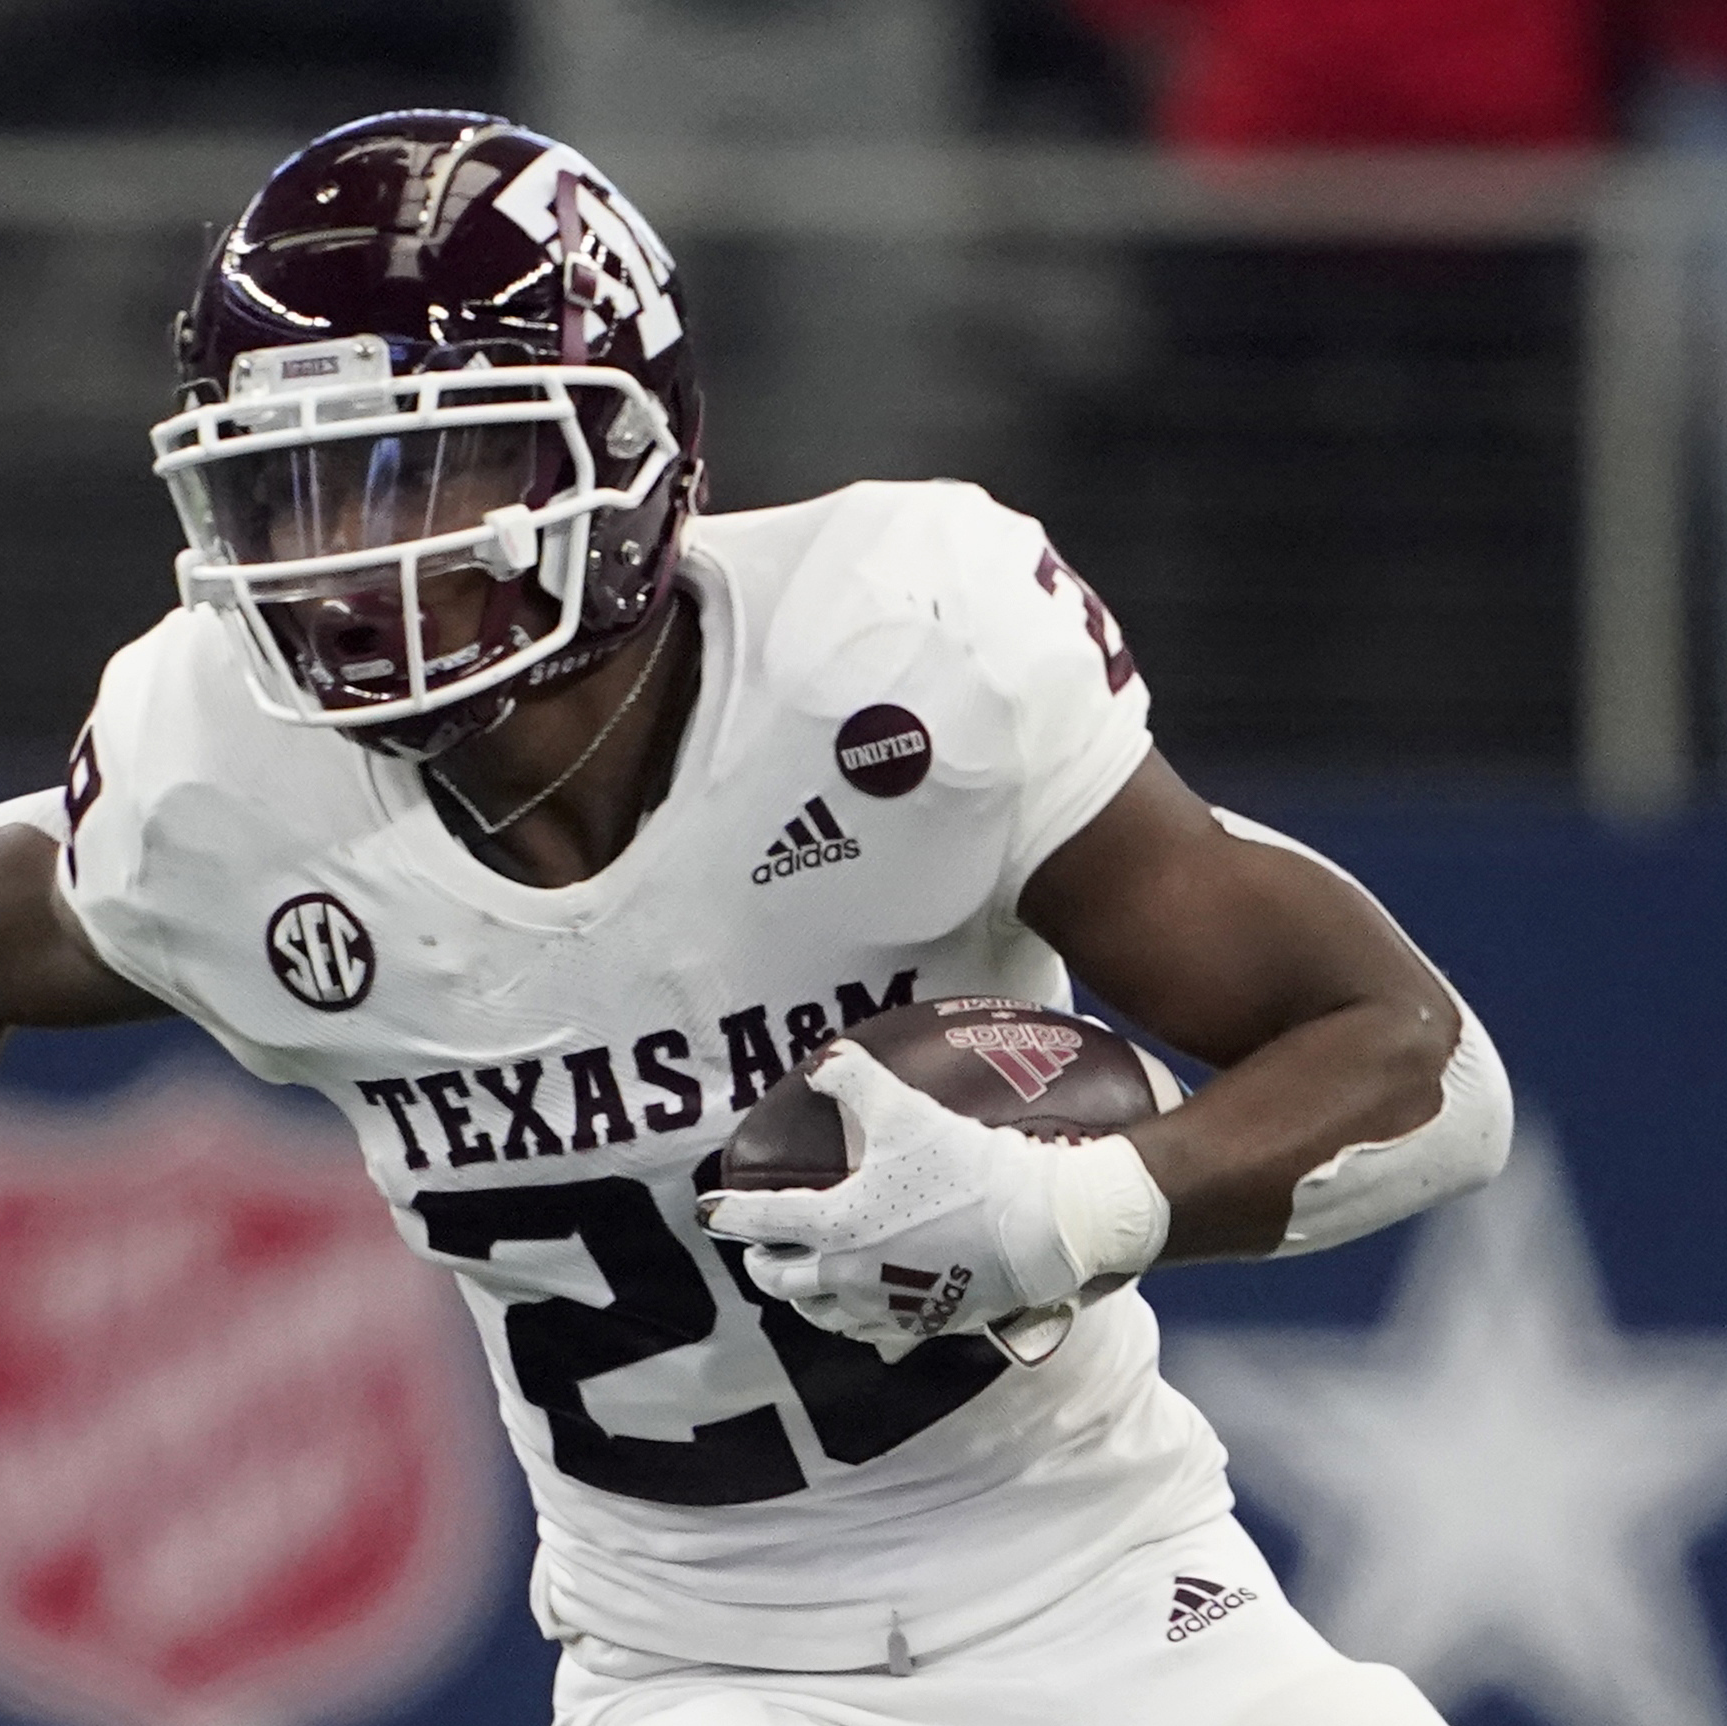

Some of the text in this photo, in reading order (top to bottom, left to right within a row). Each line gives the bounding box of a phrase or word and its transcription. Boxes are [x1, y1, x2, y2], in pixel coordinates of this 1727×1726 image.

[841, 729, 926, 771] UNIFIED
[751, 836, 861, 886] adidas
[273, 900, 368, 1001] SEC
[945, 1022, 1083, 1050] adidas
[357, 1029, 703, 1169] TEXAS
[1166, 1586, 1258, 1643] adidas
